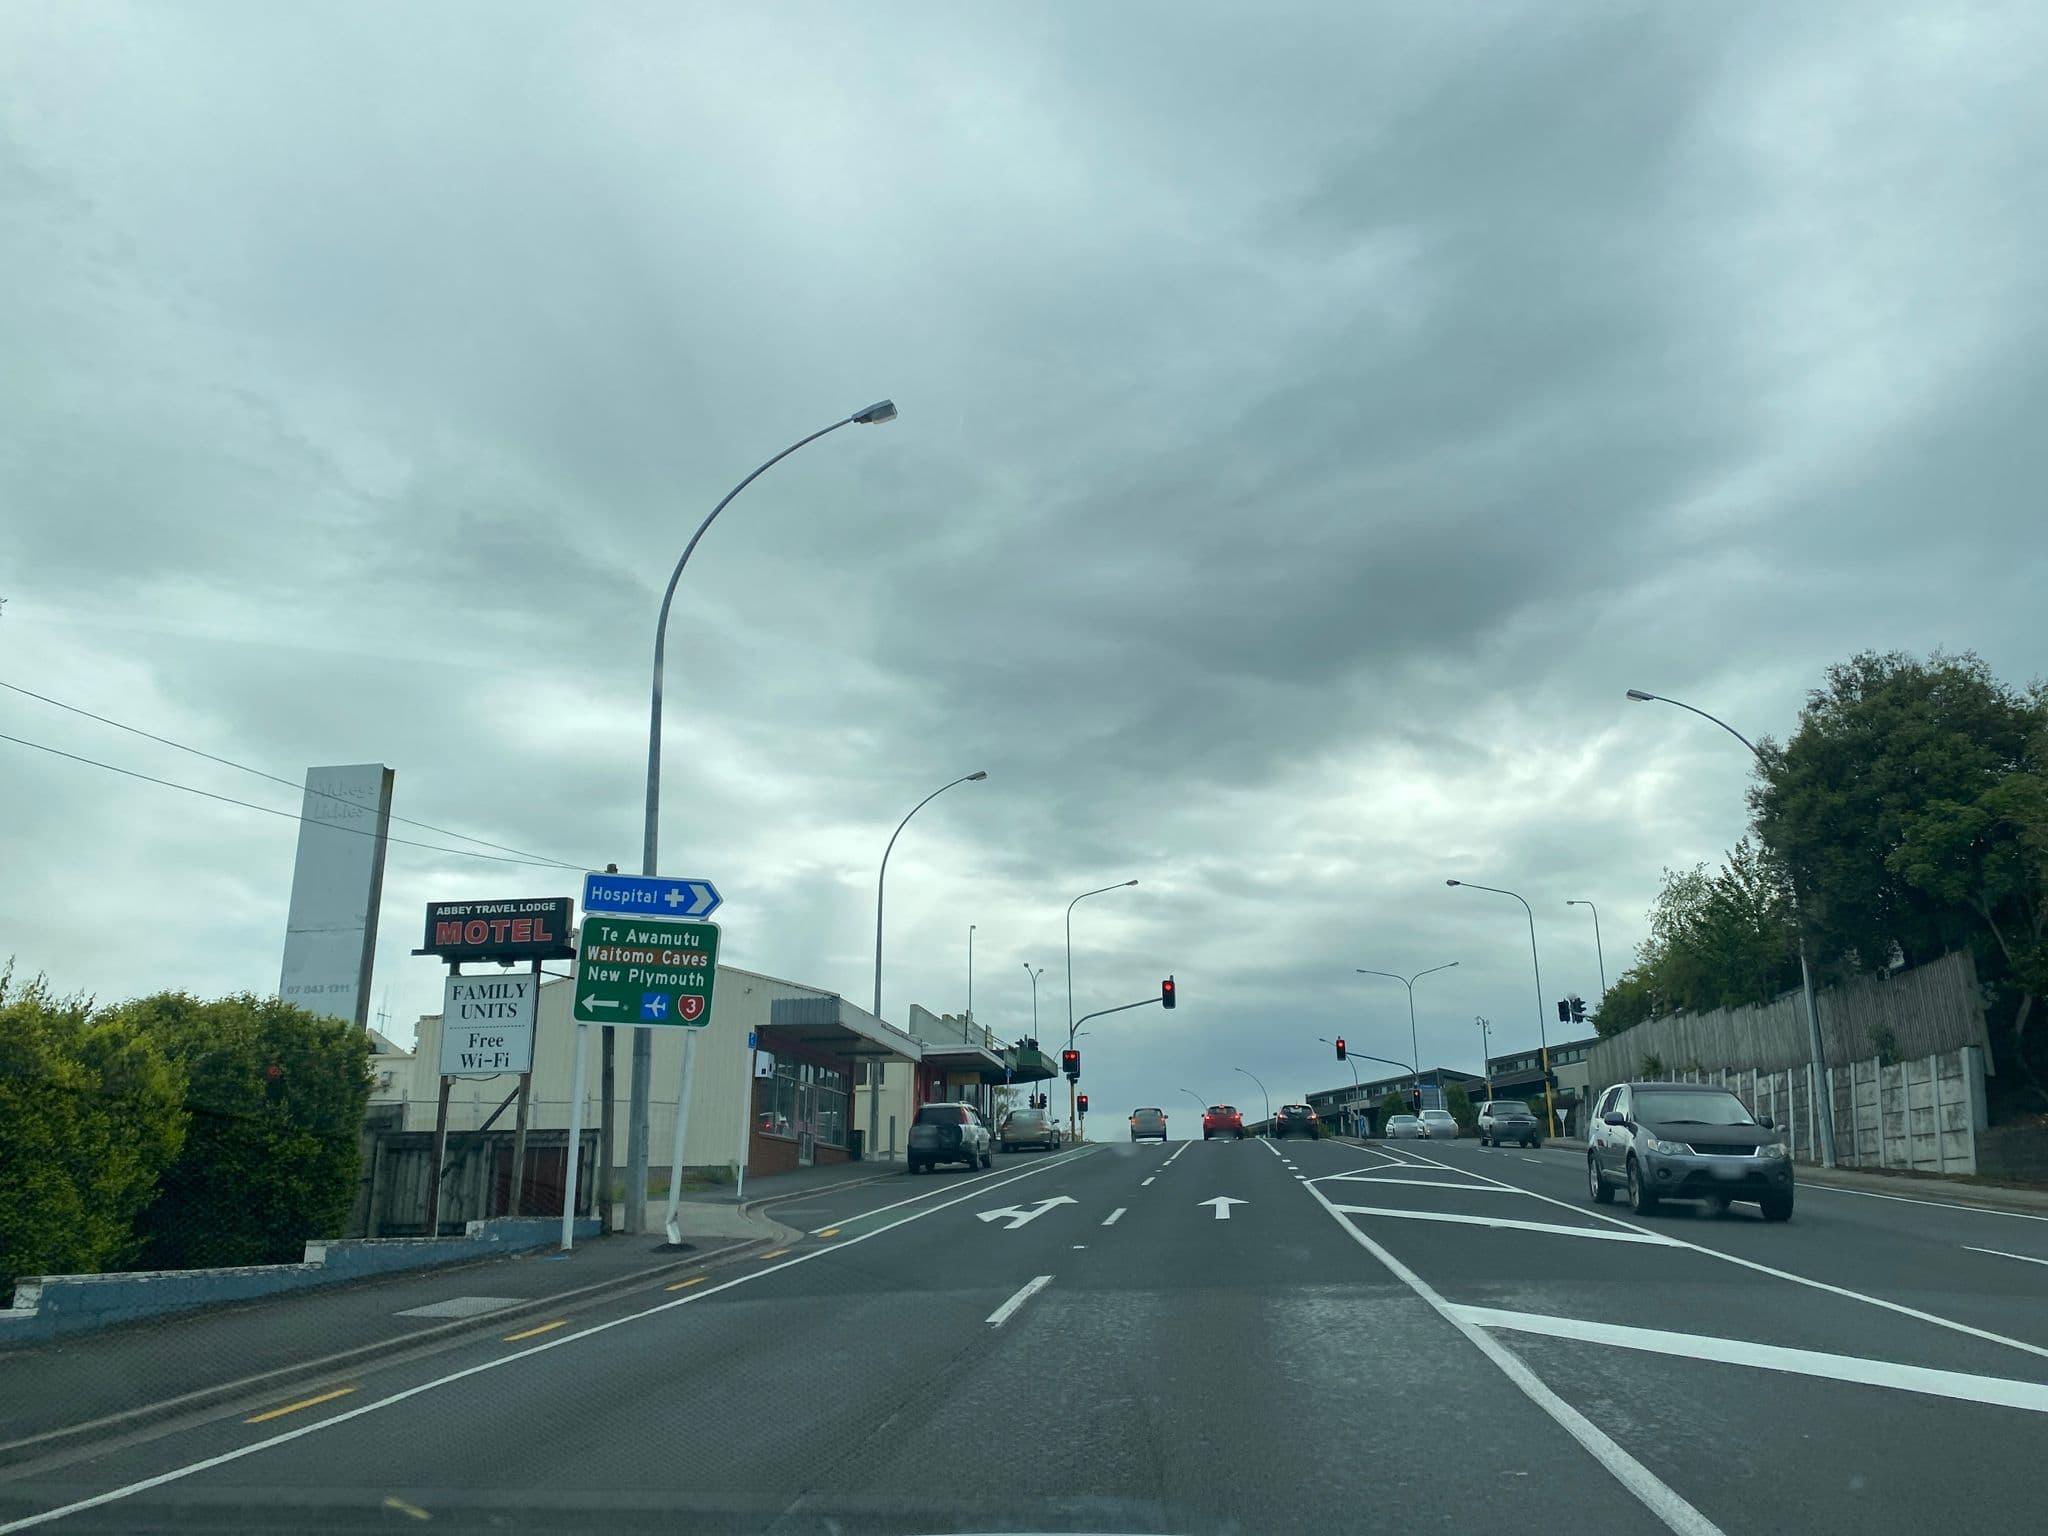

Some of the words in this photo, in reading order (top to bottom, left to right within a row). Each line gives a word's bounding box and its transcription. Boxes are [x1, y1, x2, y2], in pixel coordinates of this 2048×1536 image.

[591, 886, 657, 904] Hospital
[436, 906, 472, 915] ABBEY
[475, 904, 517, 914] TRAVEL
[519, 902, 556, 912] LODGE
[436, 918, 552, 945] MOTEL
[601, 927, 618, 941] Te
[626, 929, 699, 947] Awamutu
[587, 945, 654, 963] Waitomo
[662, 950, 708, 966] Caves
[588, 966, 620, 982] New
[628, 968, 705, 987] Plymouth
[452, 982, 528, 1001] FAMILY
[461, 1002, 517, 1020] UNITS
[686, 999, 696, 1014] 3
[469, 1033, 504, 1048] Free
[461, 1052, 509, 1069] Wi-Fi
